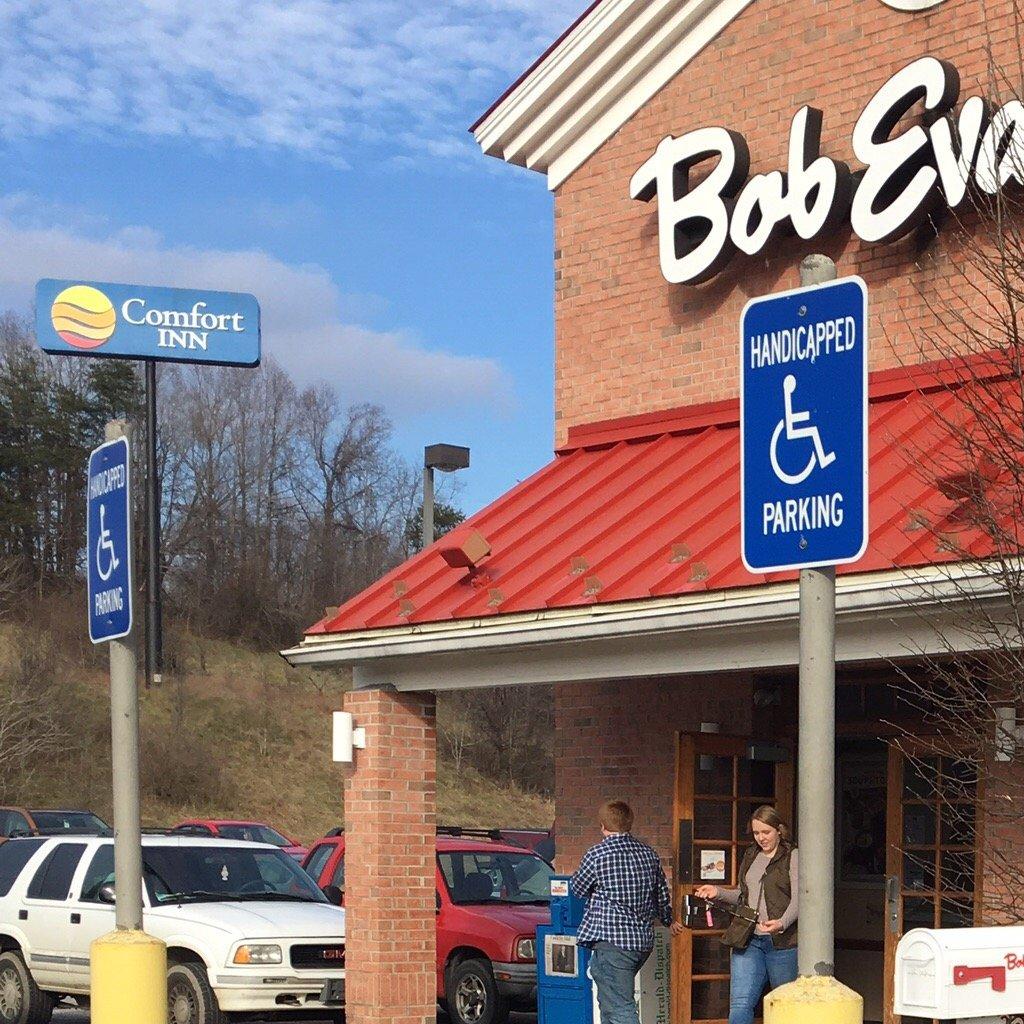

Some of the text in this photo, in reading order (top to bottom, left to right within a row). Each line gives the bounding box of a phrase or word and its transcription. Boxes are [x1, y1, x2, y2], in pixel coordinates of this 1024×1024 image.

[629, 105, 838, 285] Bob
[121, 298, 245, 332] Comfort
[157, 328, 209, 350] INN
[750, 316, 856, 369] HANDICAPPED
[90, 464, 125, 499] HANDICAPPED
[763, 492, 844, 536] PARKING
[95, 586, 123, 616] PARKING
[323, 949, 346, 959] GM
